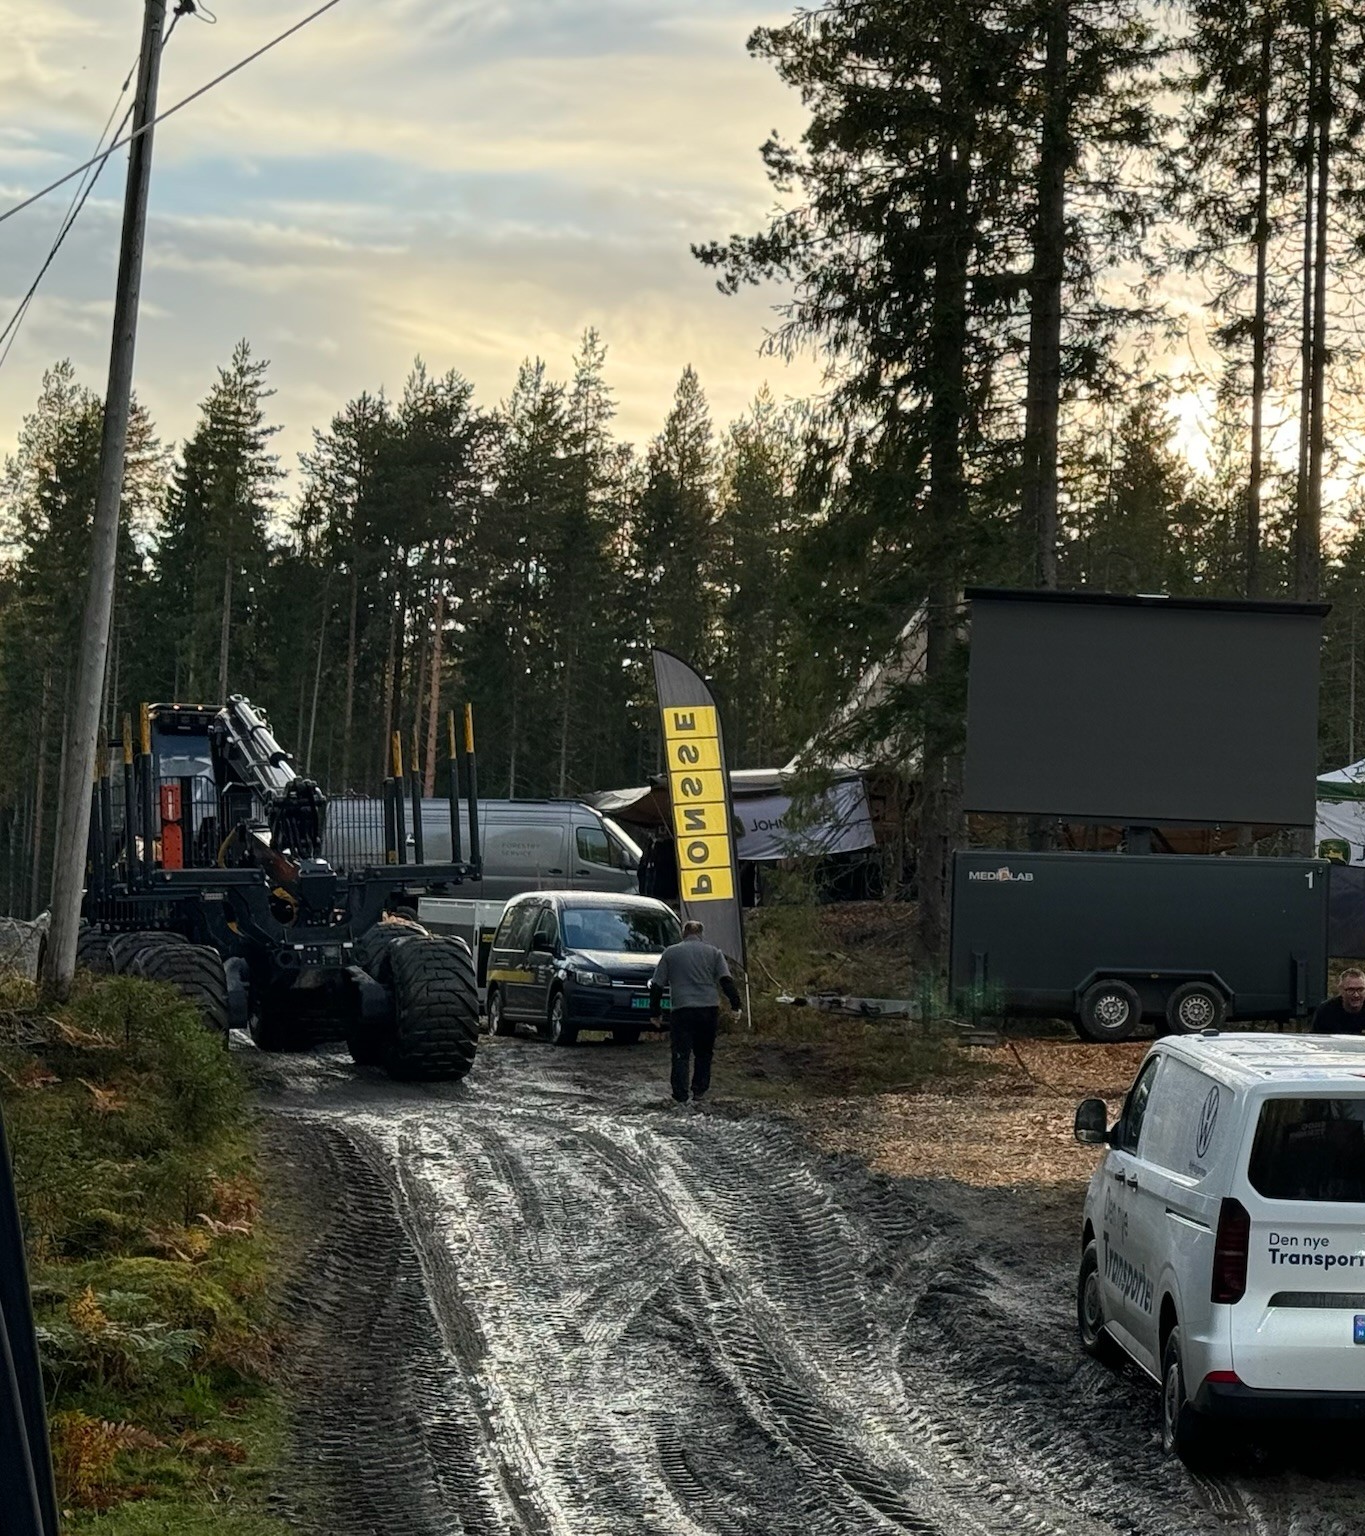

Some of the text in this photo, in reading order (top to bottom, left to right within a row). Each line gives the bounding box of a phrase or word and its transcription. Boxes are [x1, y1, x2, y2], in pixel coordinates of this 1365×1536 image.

[1304, 871, 1314, 889] 1
[1268, 1232, 1330, 1250] Den nye
